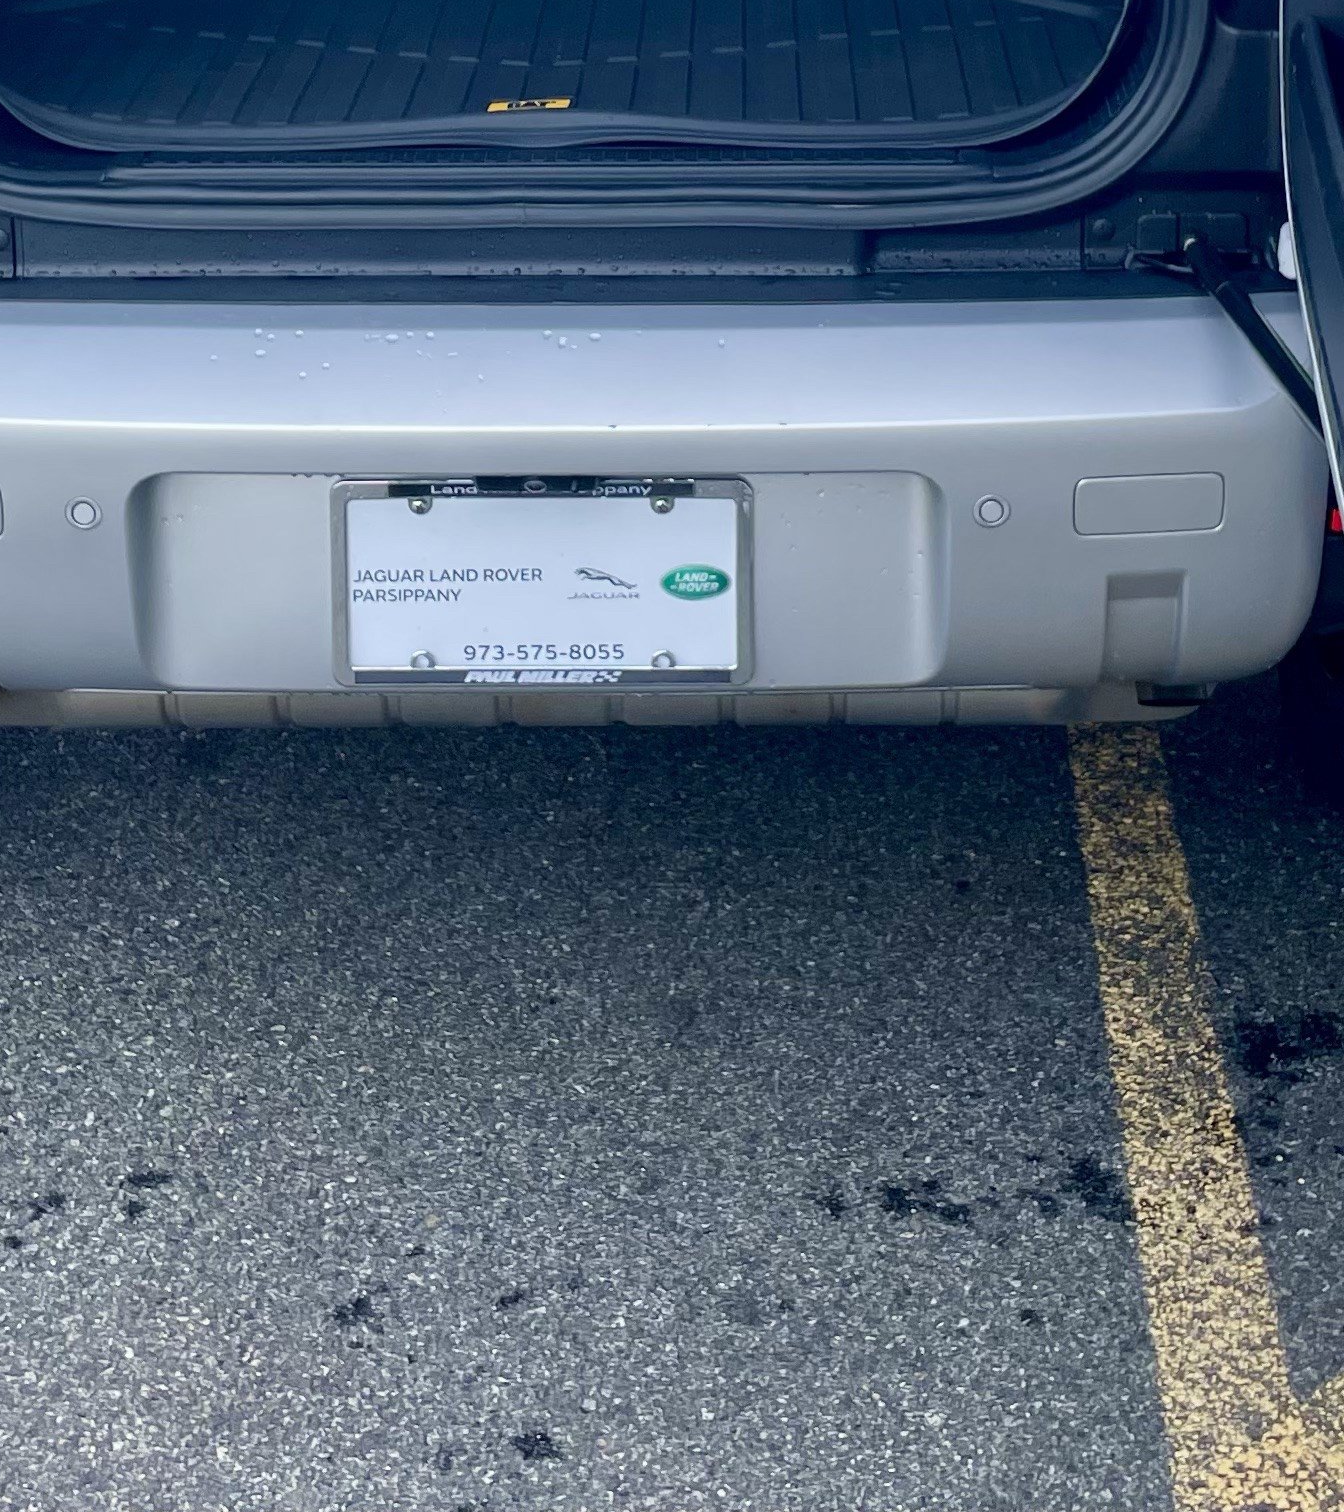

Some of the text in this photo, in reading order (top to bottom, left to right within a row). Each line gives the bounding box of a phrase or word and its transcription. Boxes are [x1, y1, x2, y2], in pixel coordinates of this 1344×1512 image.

[431, 484, 477, 495] Land
[353, 568, 543, 583] JAGUAR LAND ROVER
[352, 589, 463, 603] PARSIPPANY
[567, 591, 640, 600] JAGUAR
[463, 643, 625, 661] 973-575-8055
[464, 669, 598, 684] PAUL MILLER
